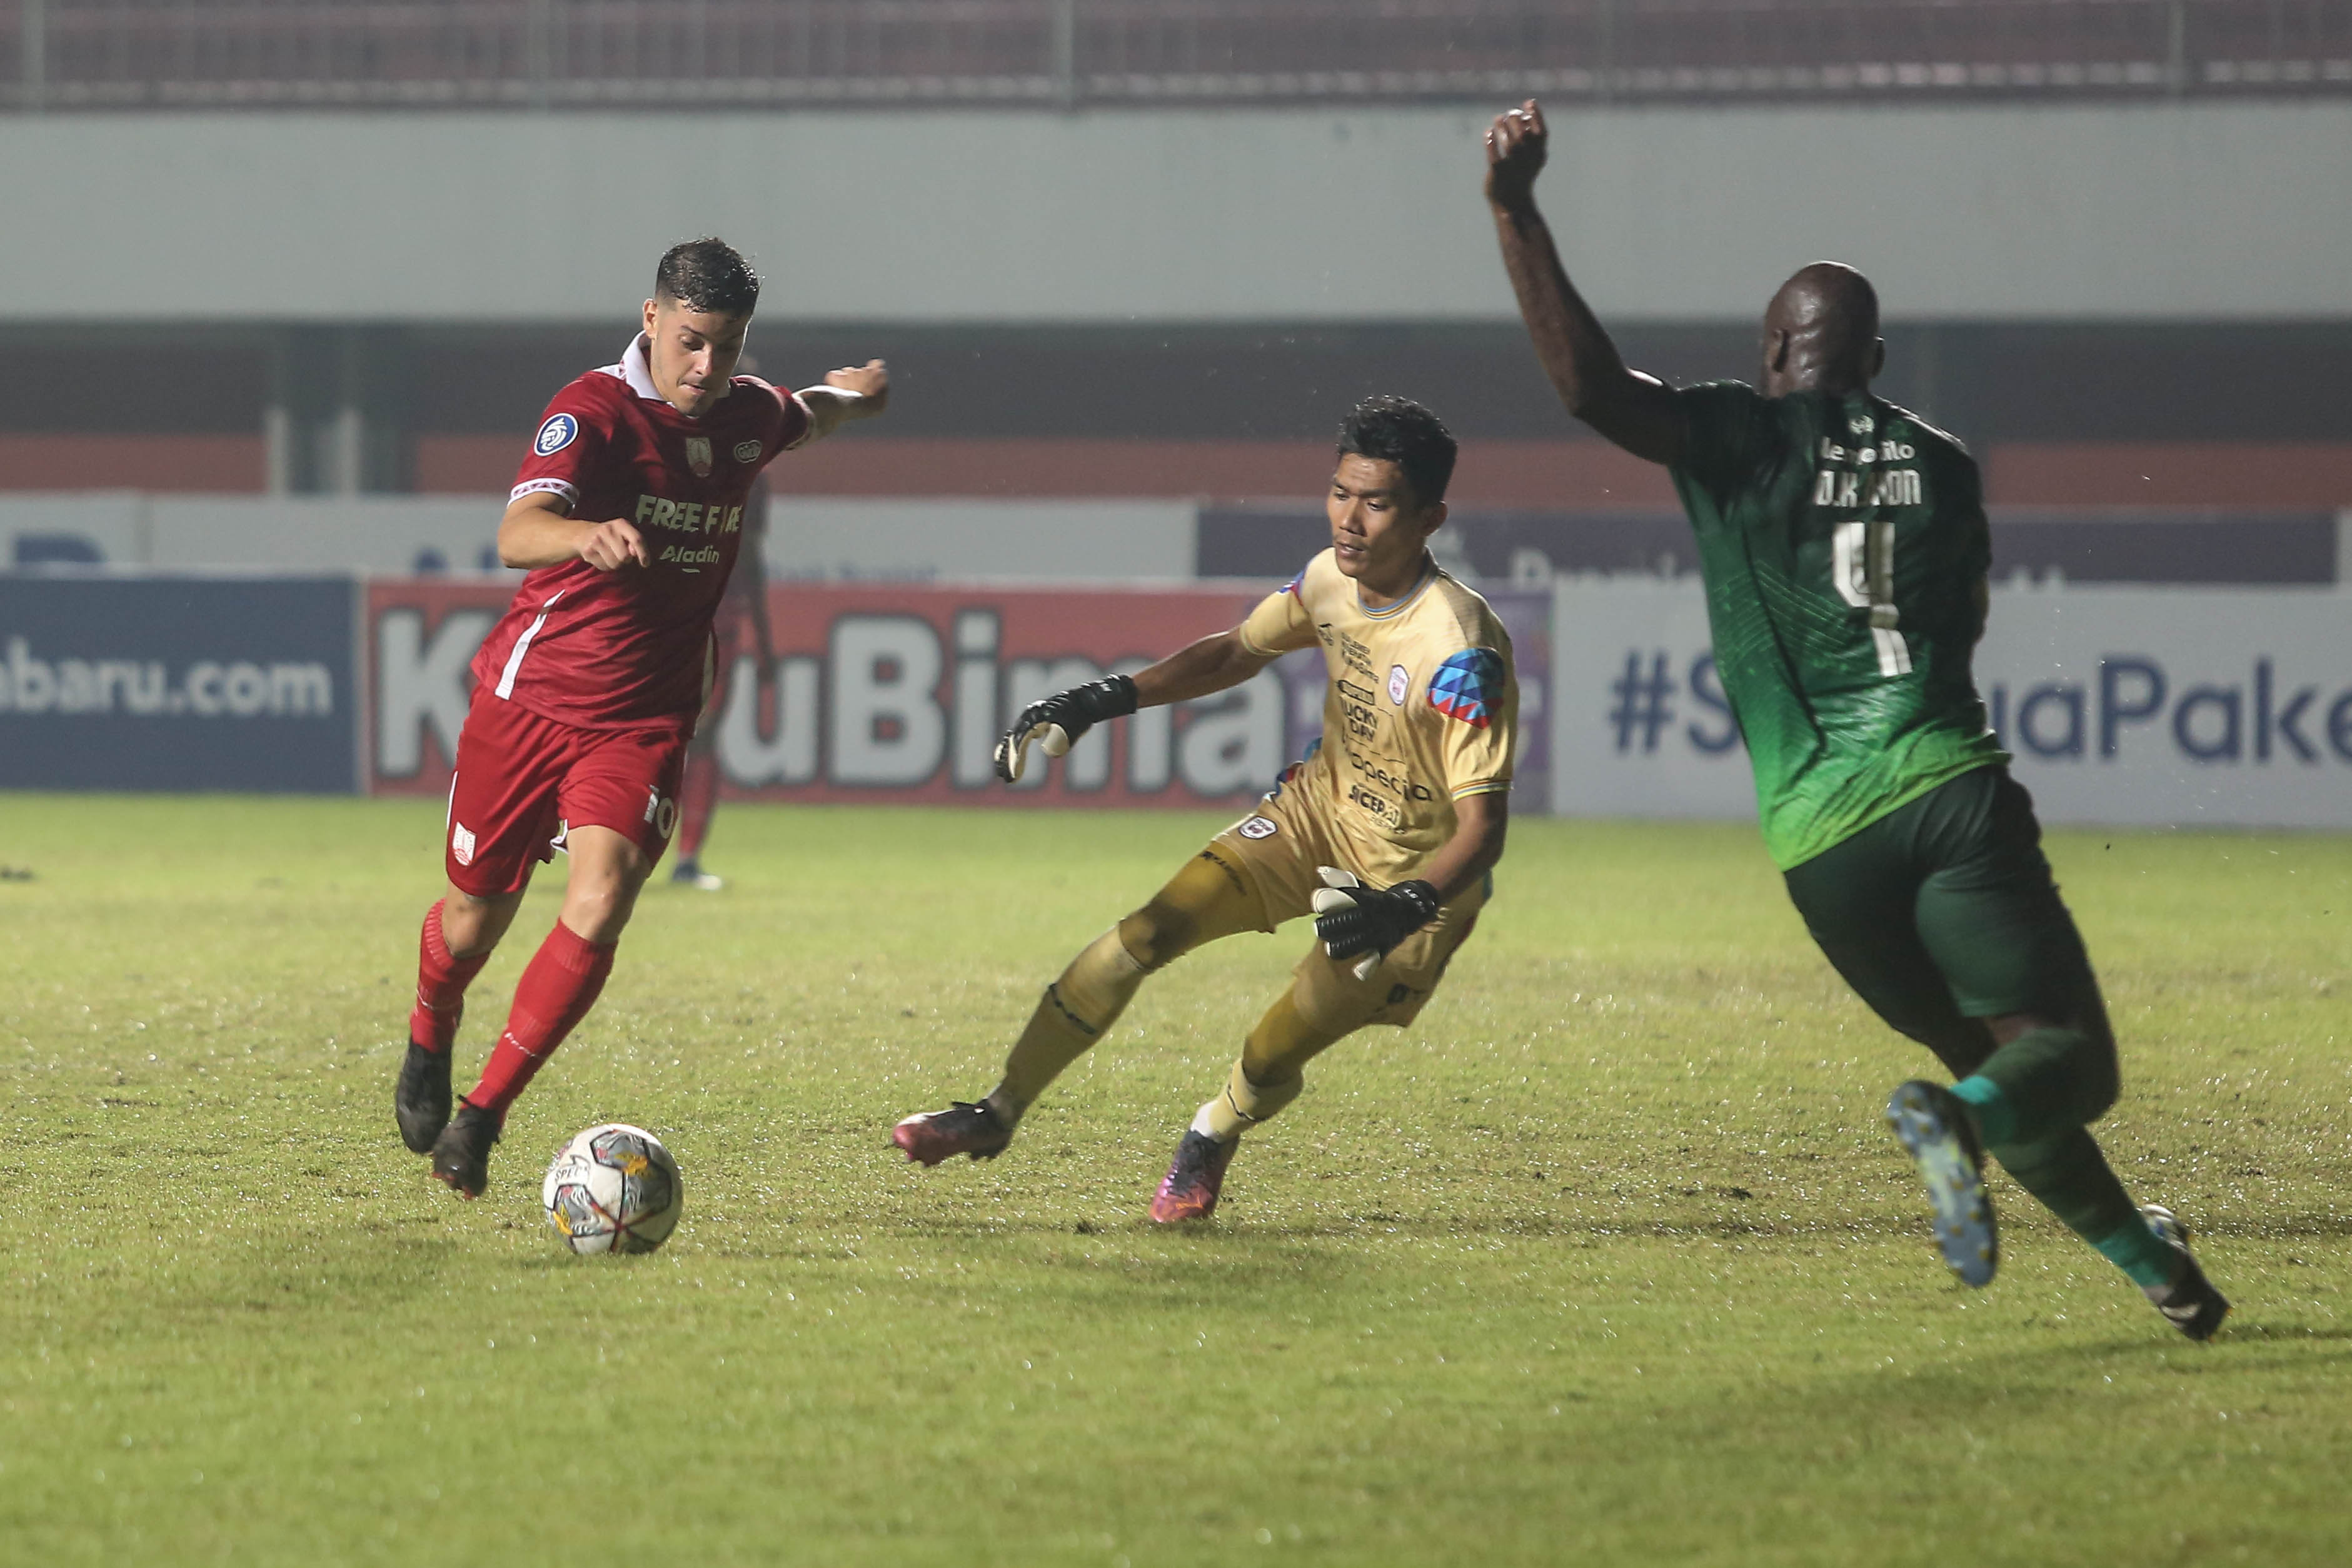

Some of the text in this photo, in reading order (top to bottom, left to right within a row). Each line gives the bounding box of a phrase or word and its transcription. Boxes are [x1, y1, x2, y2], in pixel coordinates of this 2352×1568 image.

[635, 494, 703, 533] FREE
[659, 545, 720, 564] Aladin
[0, 636, 333, 716] baru.com
[375, 603, 1287, 791] KuBima
